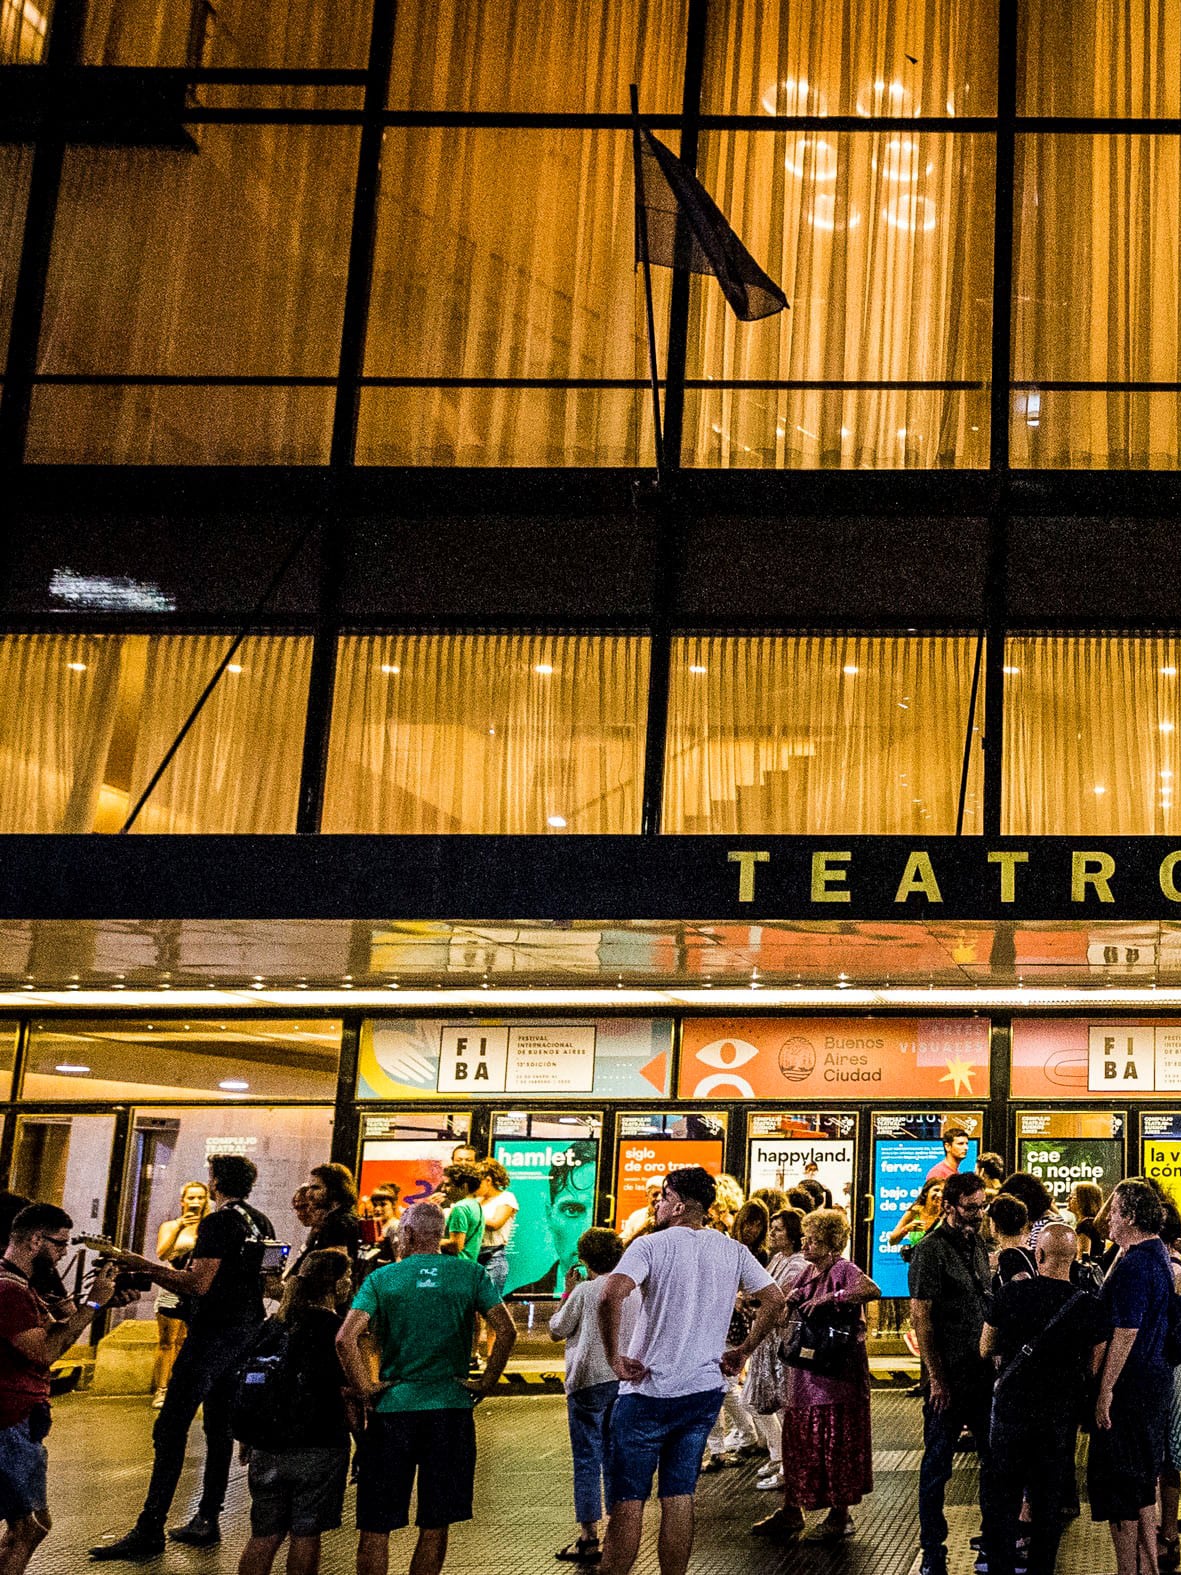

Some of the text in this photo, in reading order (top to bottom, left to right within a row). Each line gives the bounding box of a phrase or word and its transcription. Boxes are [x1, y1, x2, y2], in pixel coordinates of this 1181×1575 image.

[824, 1036, 885, 1050] Buenos
[824, 1052, 868, 1066] Aires
[824, 1068, 882, 1082] Ciudad
[498, 1146, 582, 1167] hamlet.
[625, 1147, 655, 1162] siglo
[758, 1147, 851, 1166] happyland.
[1027, 1151, 1061, 1163] cae
[1151, 1147, 1165, 1162] la
[624, 1160, 642, 1172] de
[643, 1162, 666, 1172] oro
[881, 1160, 922, 1173] fervor.
[1027, 1162, 1104, 1178] la noche
[880, 1186, 908, 1200] bajo
[880, 1199, 898, 1211] de
